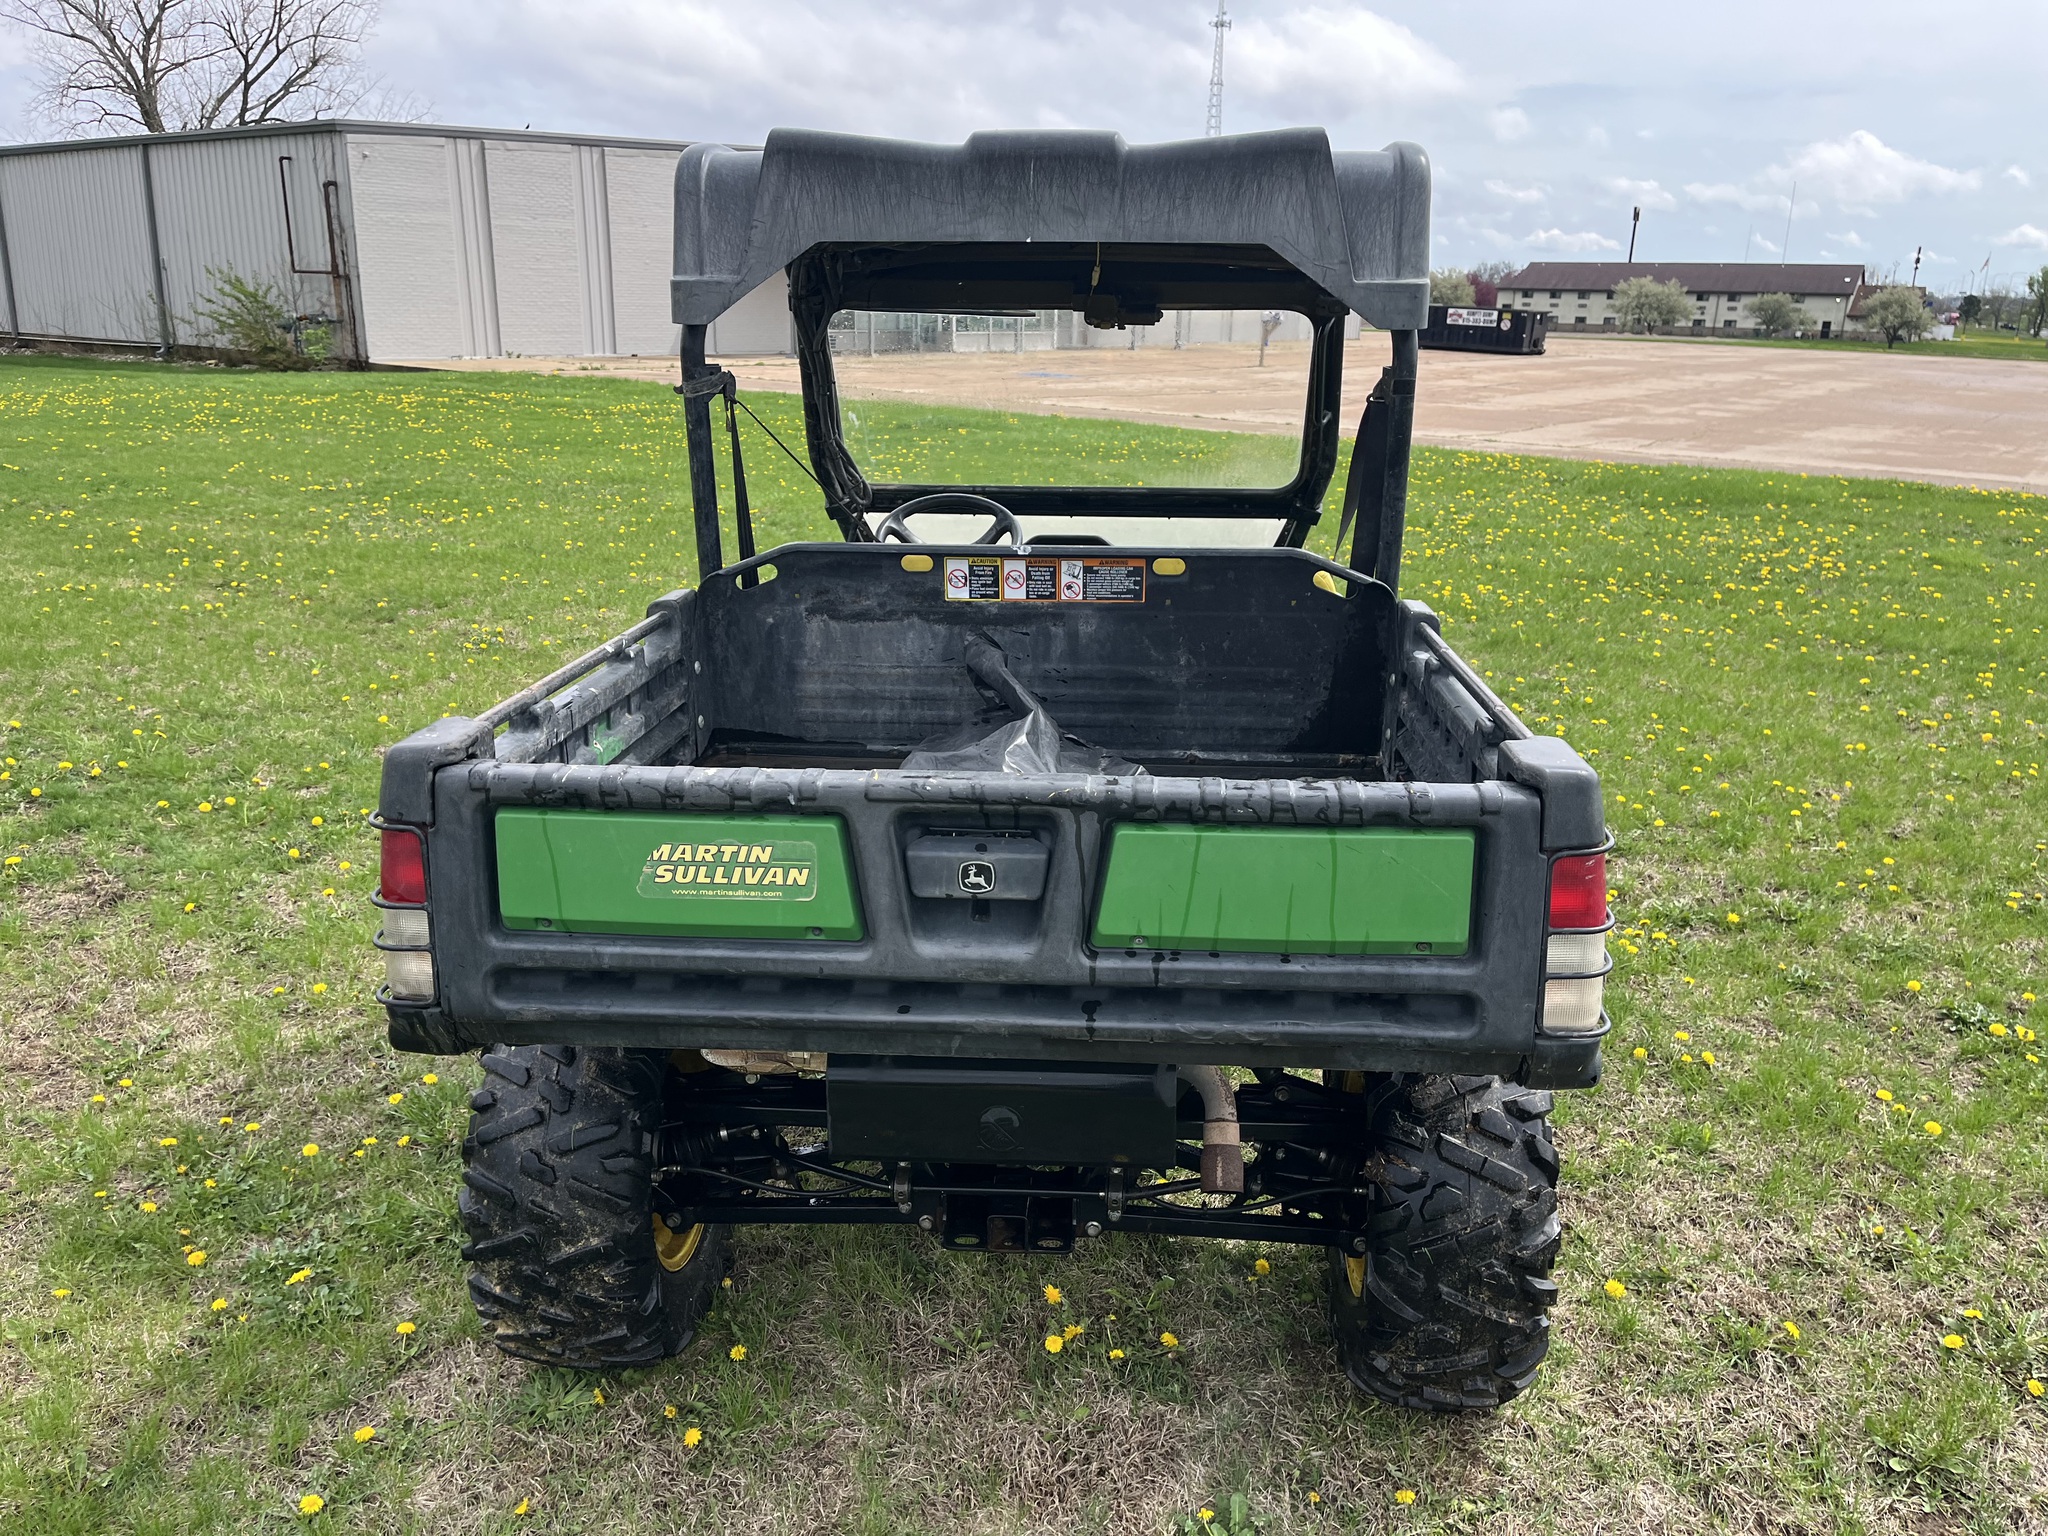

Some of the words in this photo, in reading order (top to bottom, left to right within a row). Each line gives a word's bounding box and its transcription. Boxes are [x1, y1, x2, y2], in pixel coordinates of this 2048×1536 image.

[647, 844, 773, 864] MARTIN
[653, 864, 810, 886] SULLIVAN
[671, 889, 782, 897] www.martinsullivan.com
